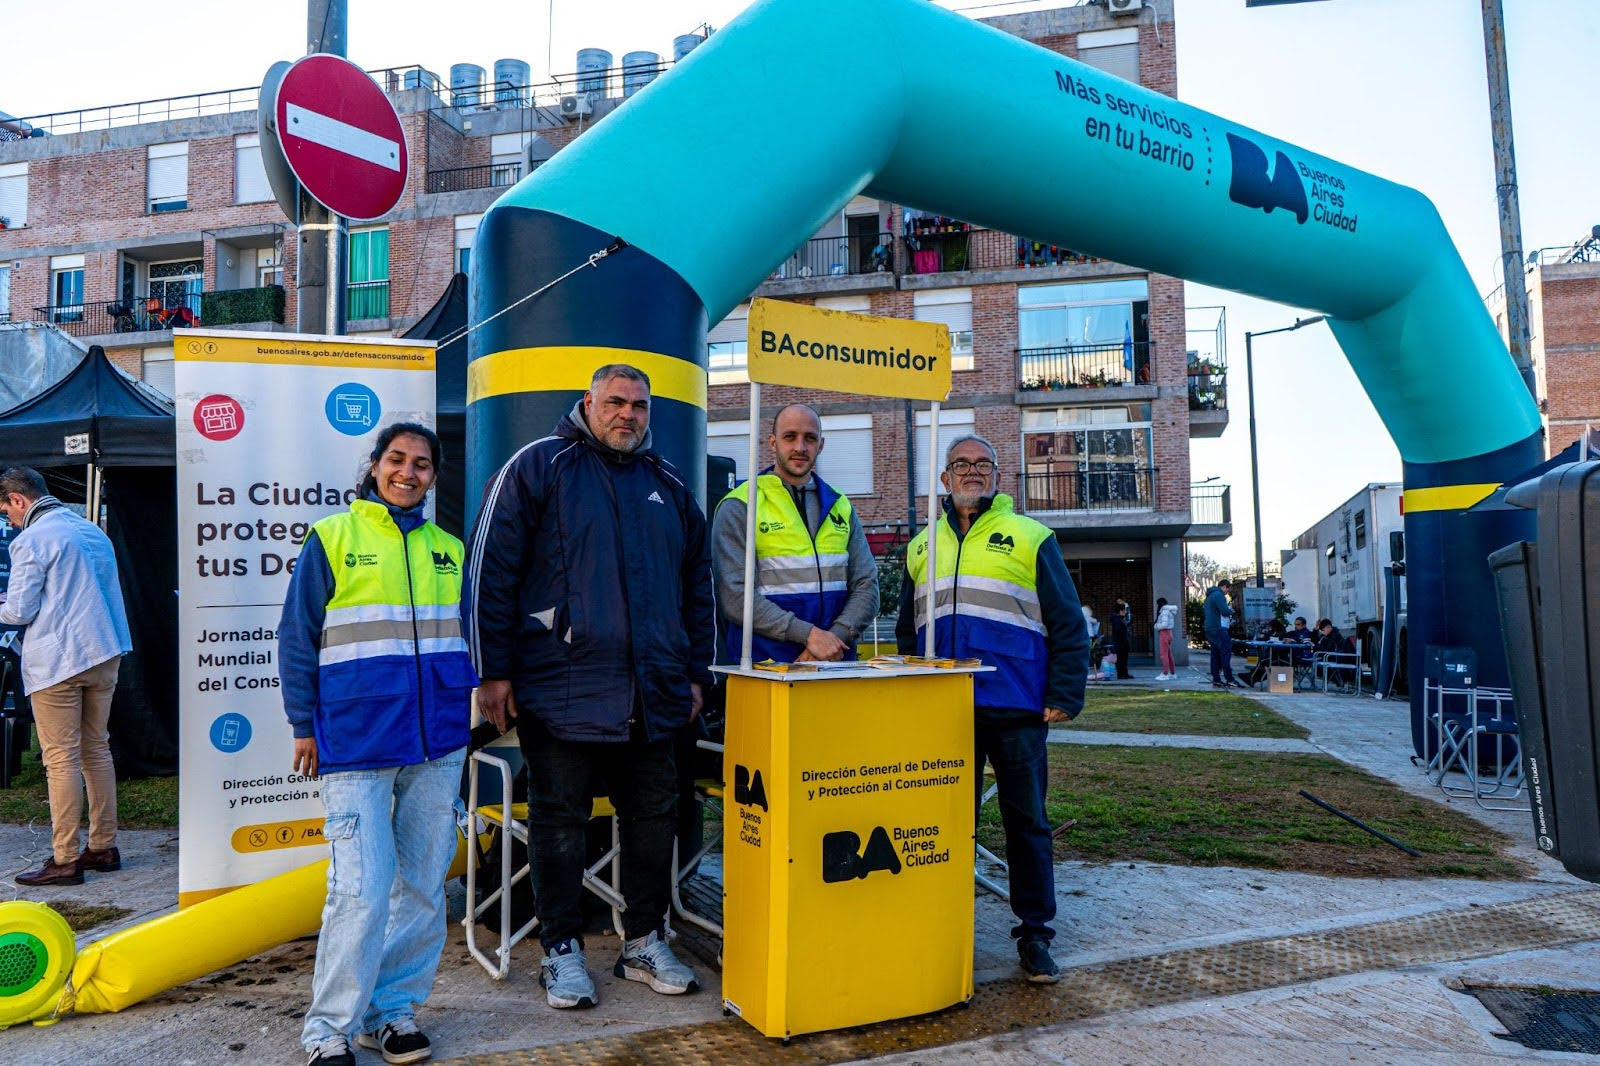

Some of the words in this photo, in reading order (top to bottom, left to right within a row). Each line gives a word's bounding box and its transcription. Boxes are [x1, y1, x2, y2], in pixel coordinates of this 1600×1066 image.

[1054, 69, 1101, 105] Más
[1105, 90, 1193, 139] servicios
[1085, 116, 1111, 142] en
[1115, 122, 1134, 151] tu
[1138, 128, 1194, 171] barrio
[1297, 160, 1346, 191] Buenos
[1311, 182, 1344, 208] Aires
[1312, 203, 1358, 233] Ciudad
[257, 346, 425, 361] buenosaires.gob.ar/defensaconsumidor
[761, 330, 937, 371] BAconsumidor
[197, 482, 235, 505] La
[197, 519, 309, 546] proteg
[197, 554, 248, 577] tus
[261, 553, 299, 576] De
[198, 650, 271, 667] Mundial
[198, 676, 227, 692] del
[234, 676, 280, 689] Cons
[802, 766, 856, 782] Dirección
[859, 762, 902, 776] General
[904, 761, 919, 772] de
[921, 757, 965, 771] Defensa
[1530, 757, 1539, 785] Ciudad
[223, 775, 283, 790] Dirección
[808, 788, 815, 800] y
[819, 781, 880, 798] Protección
[882, 780, 893, 791] al
[895, 774, 960, 790] Consumidor
[229, 799, 237, 808] y
[241, 790, 308, 806] Protección
[1534, 785, 1542, 805] Aires
[740, 808, 761, 824] Buenos
[1538, 806, 1547, 834] Buenos
[301, 828, 324, 839] /BA
[742, 820, 759, 835] Aires
[893, 825, 939, 840] Buenos
[740, 830, 761, 848] Ciudad
[902, 839, 935, 854] Aires
[906, 849, 949, 868] Ciudad
